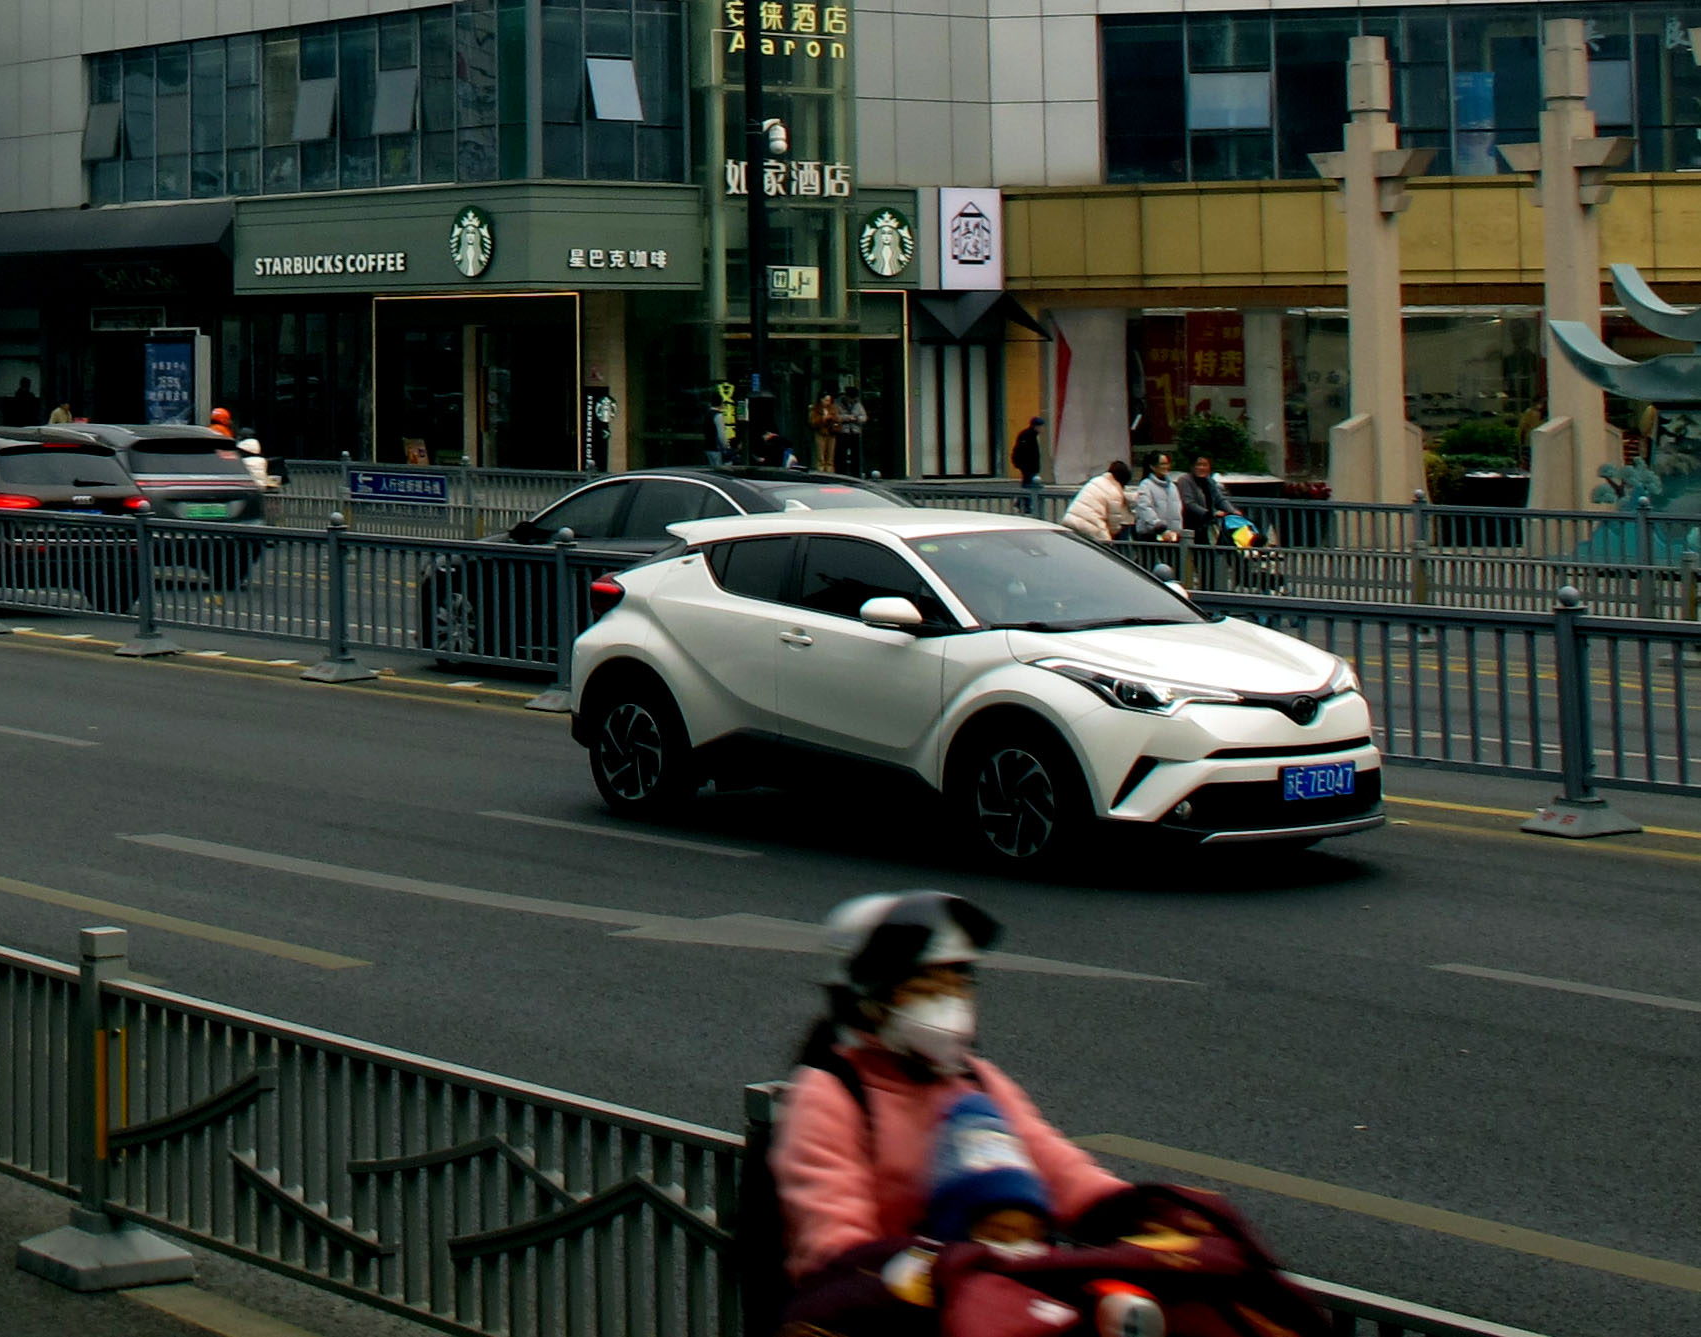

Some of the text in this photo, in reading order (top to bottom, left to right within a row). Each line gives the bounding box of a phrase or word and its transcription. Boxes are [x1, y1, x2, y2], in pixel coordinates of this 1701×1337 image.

[727, 31, 845, 59] Aaron
[725, 158, 852, 198] 如家酒店
[254, 252, 406, 276] STARBUCKS COFFEE
[568, 248, 668, 269] 星巴克咖啡
